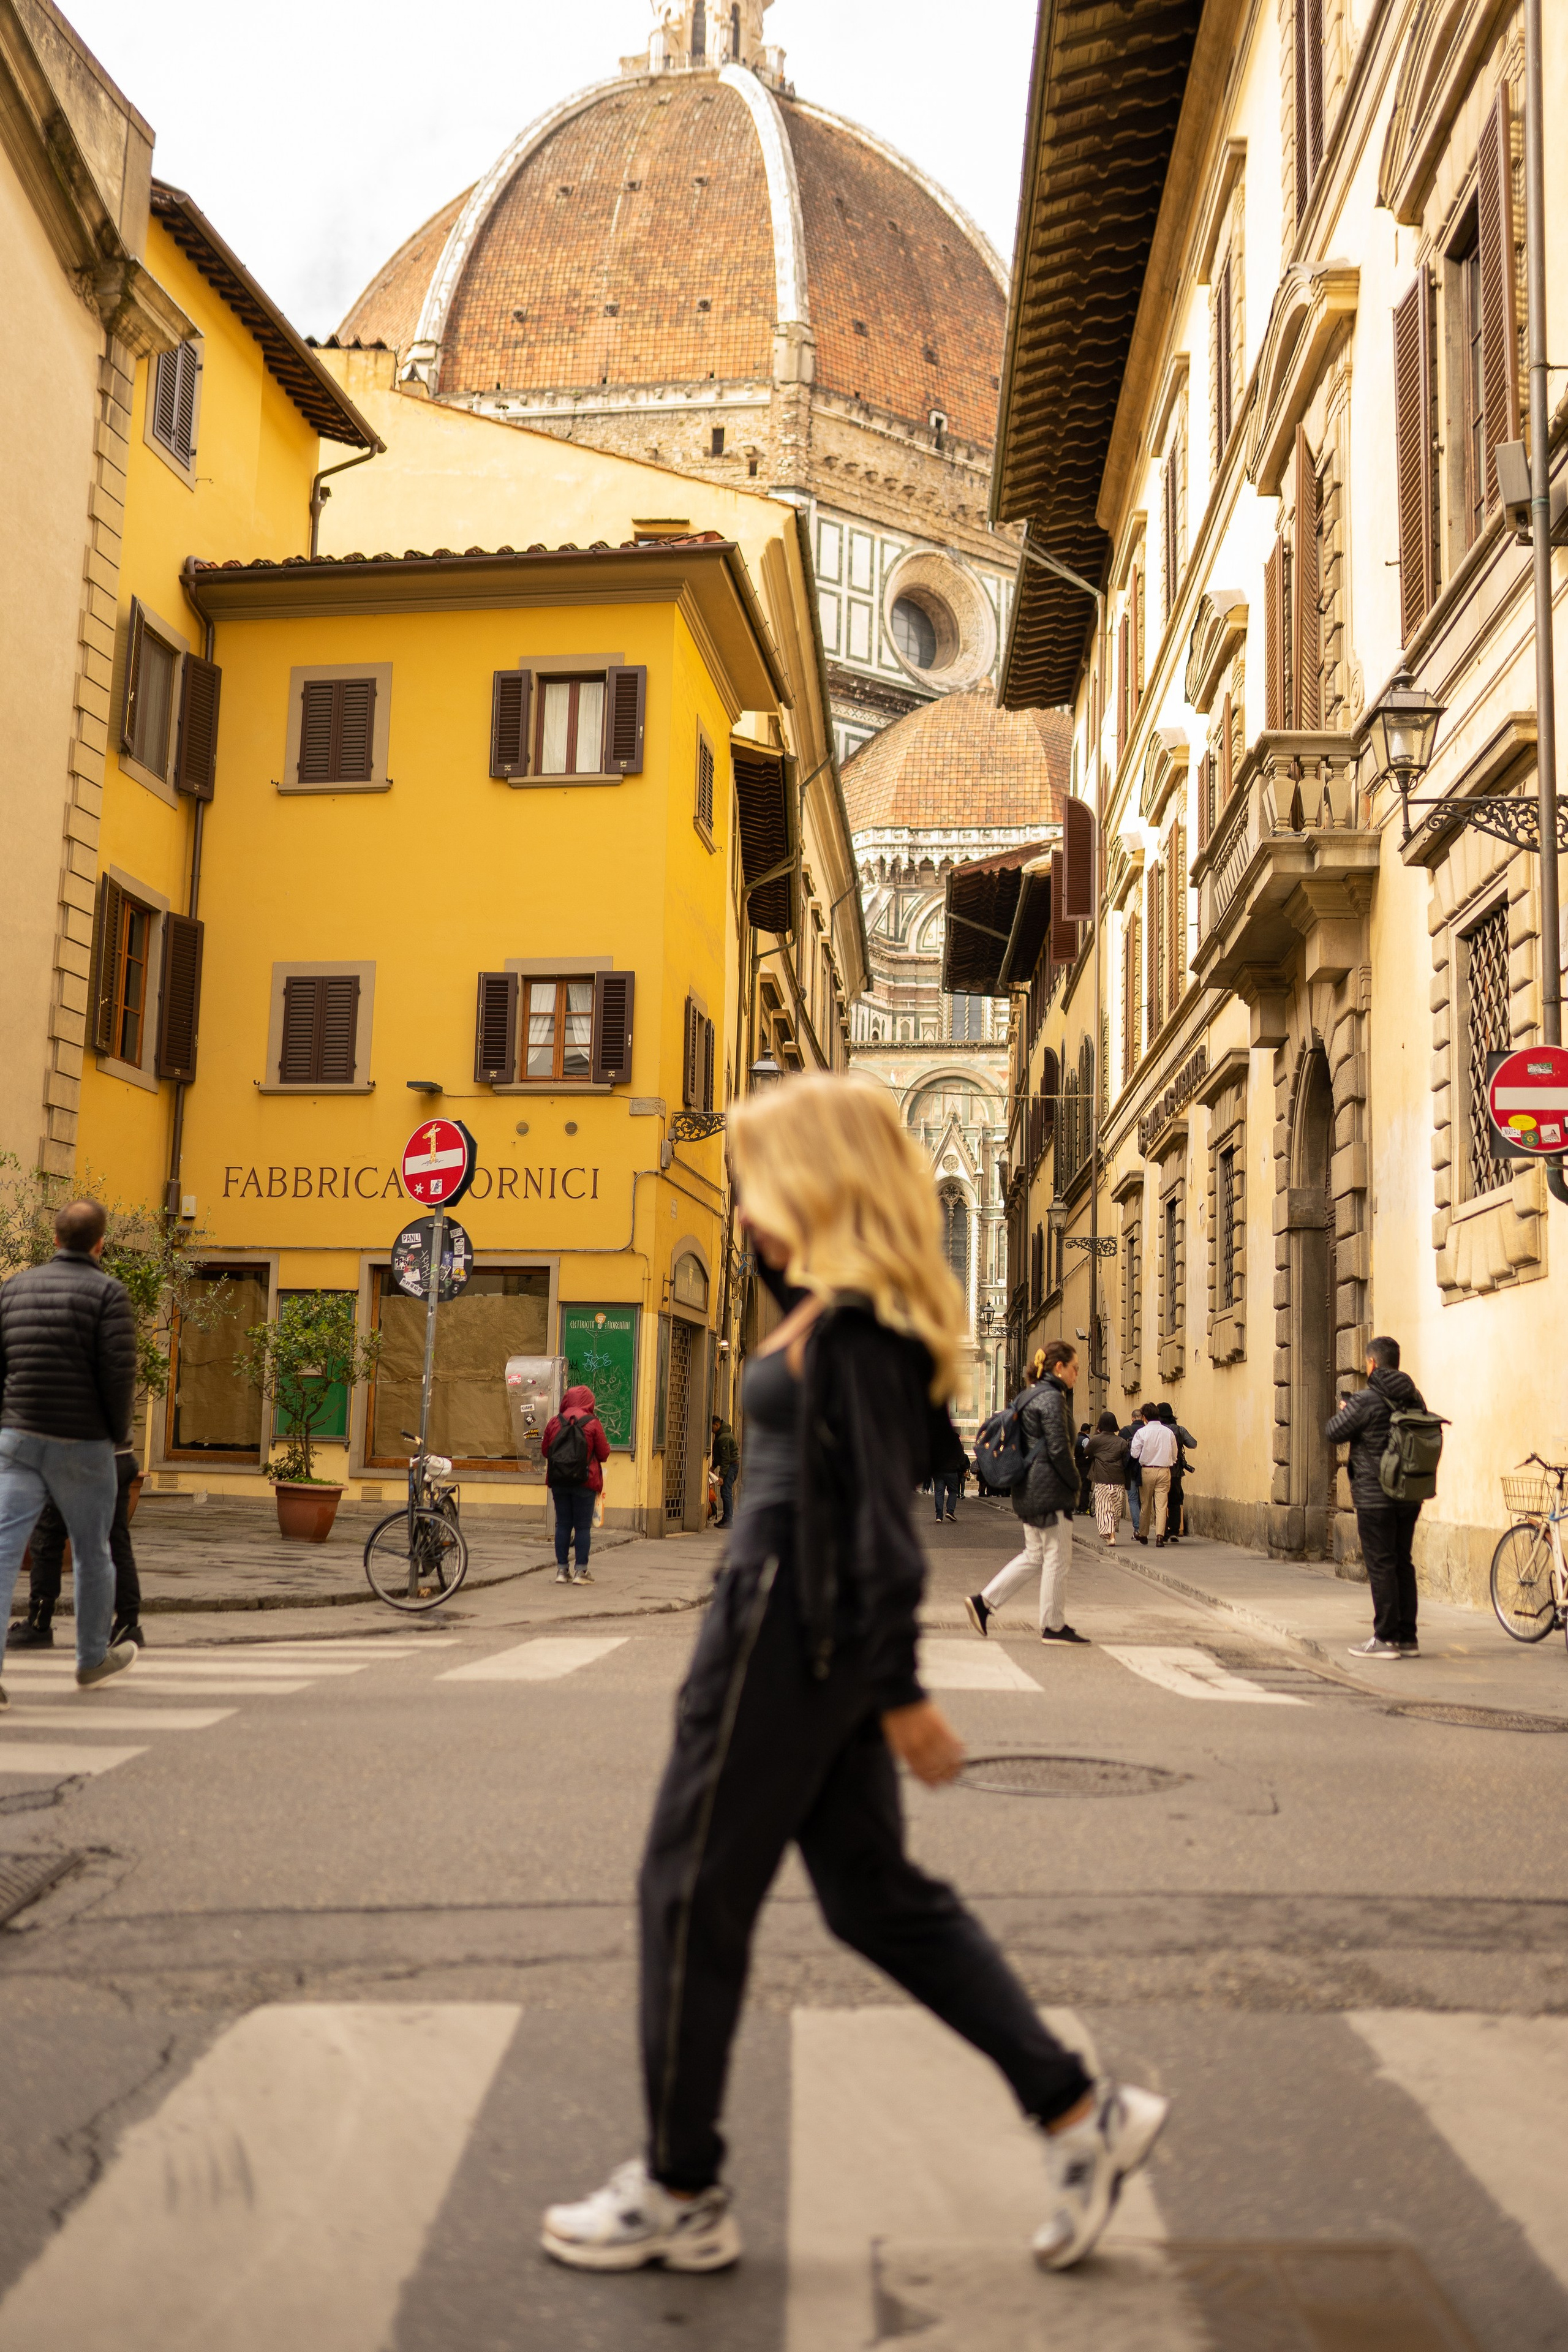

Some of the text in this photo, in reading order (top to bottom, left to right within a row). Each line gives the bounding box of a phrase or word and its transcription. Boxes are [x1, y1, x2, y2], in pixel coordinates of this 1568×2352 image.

[1174, 1045, 1206, 1099] FIRENZE
[222, 1166, 600, 1199] FABBRICA ORNICI
[403, 1234, 420, 1242] PANL!
[607, 1321, 630, 1330] FIORENTINI
